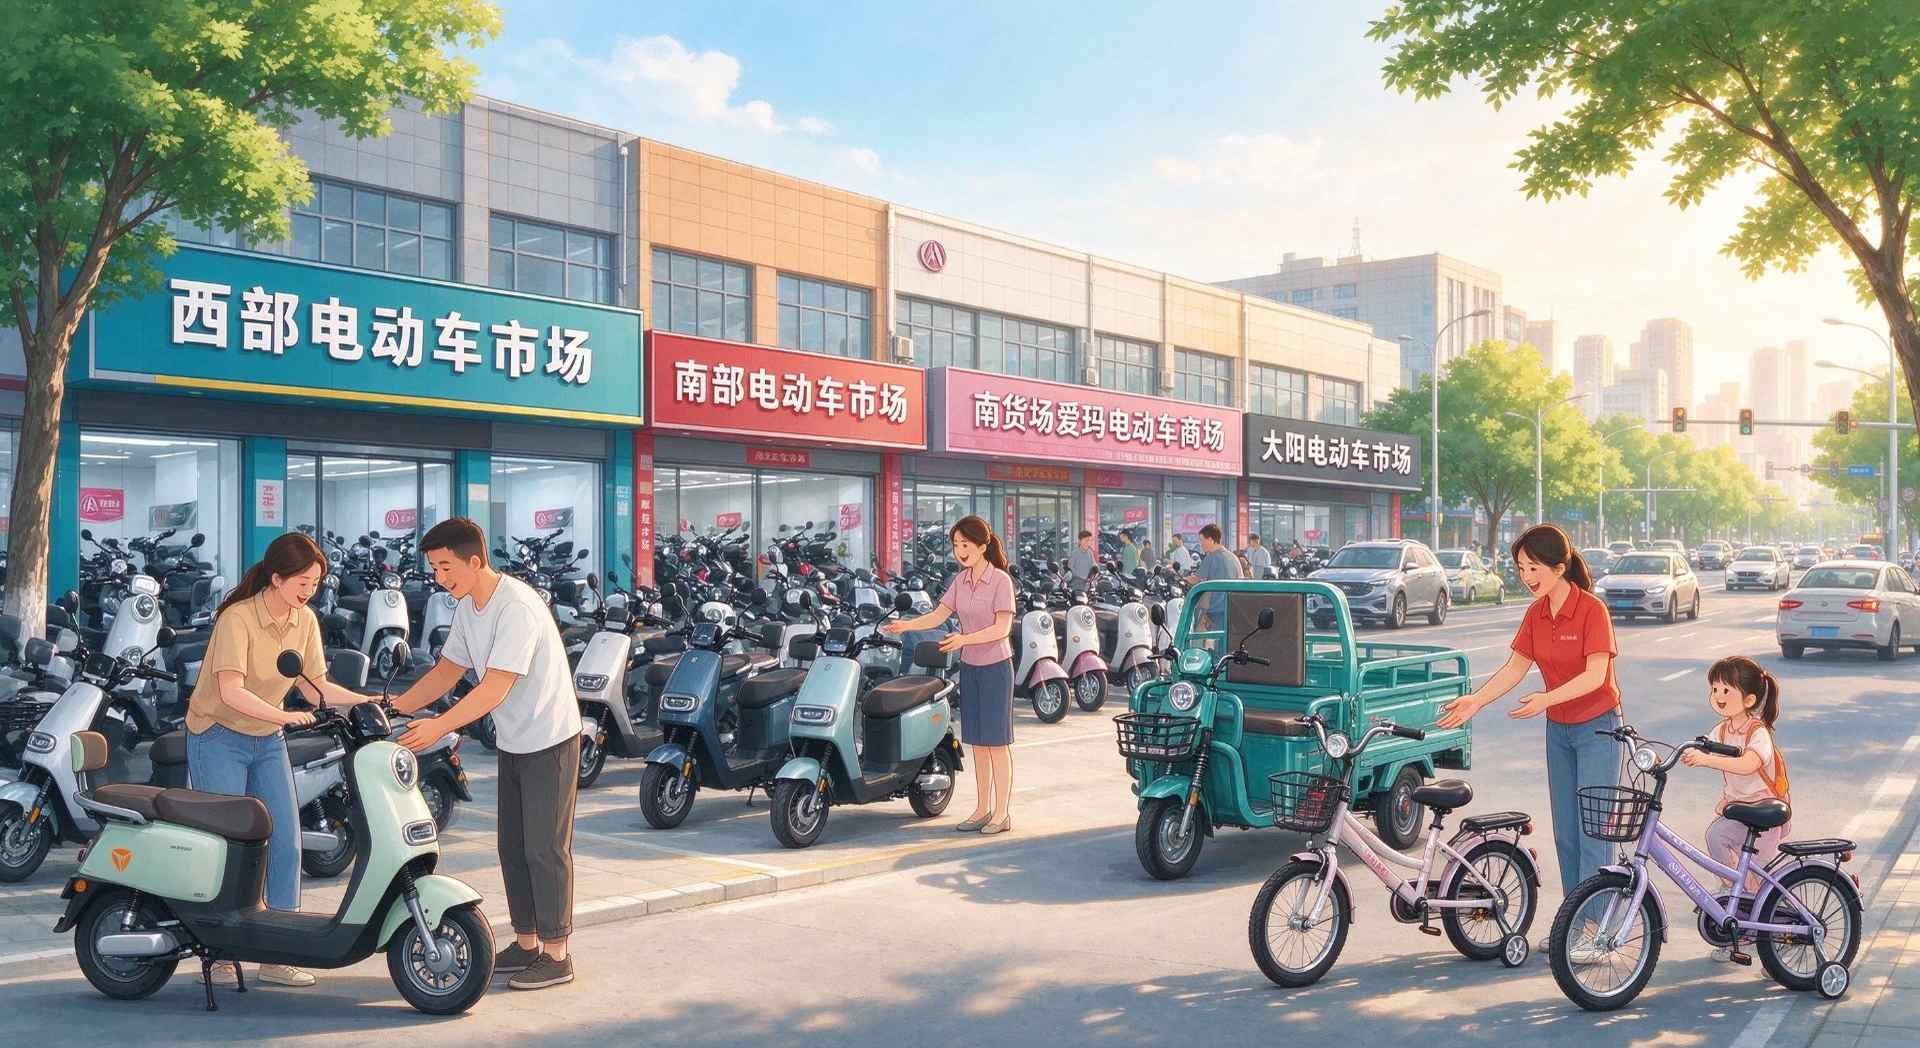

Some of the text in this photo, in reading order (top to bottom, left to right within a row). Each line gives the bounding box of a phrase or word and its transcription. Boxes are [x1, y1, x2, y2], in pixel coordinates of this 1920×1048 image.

[171, 278, 592, 384] 西部电动车市场
[675, 360, 908, 423] 南部电动车市场
[974, 391, 1225, 452] 南货场爱玛电动车商场
[1262, 429, 1411, 475] 大阳电动车市场
